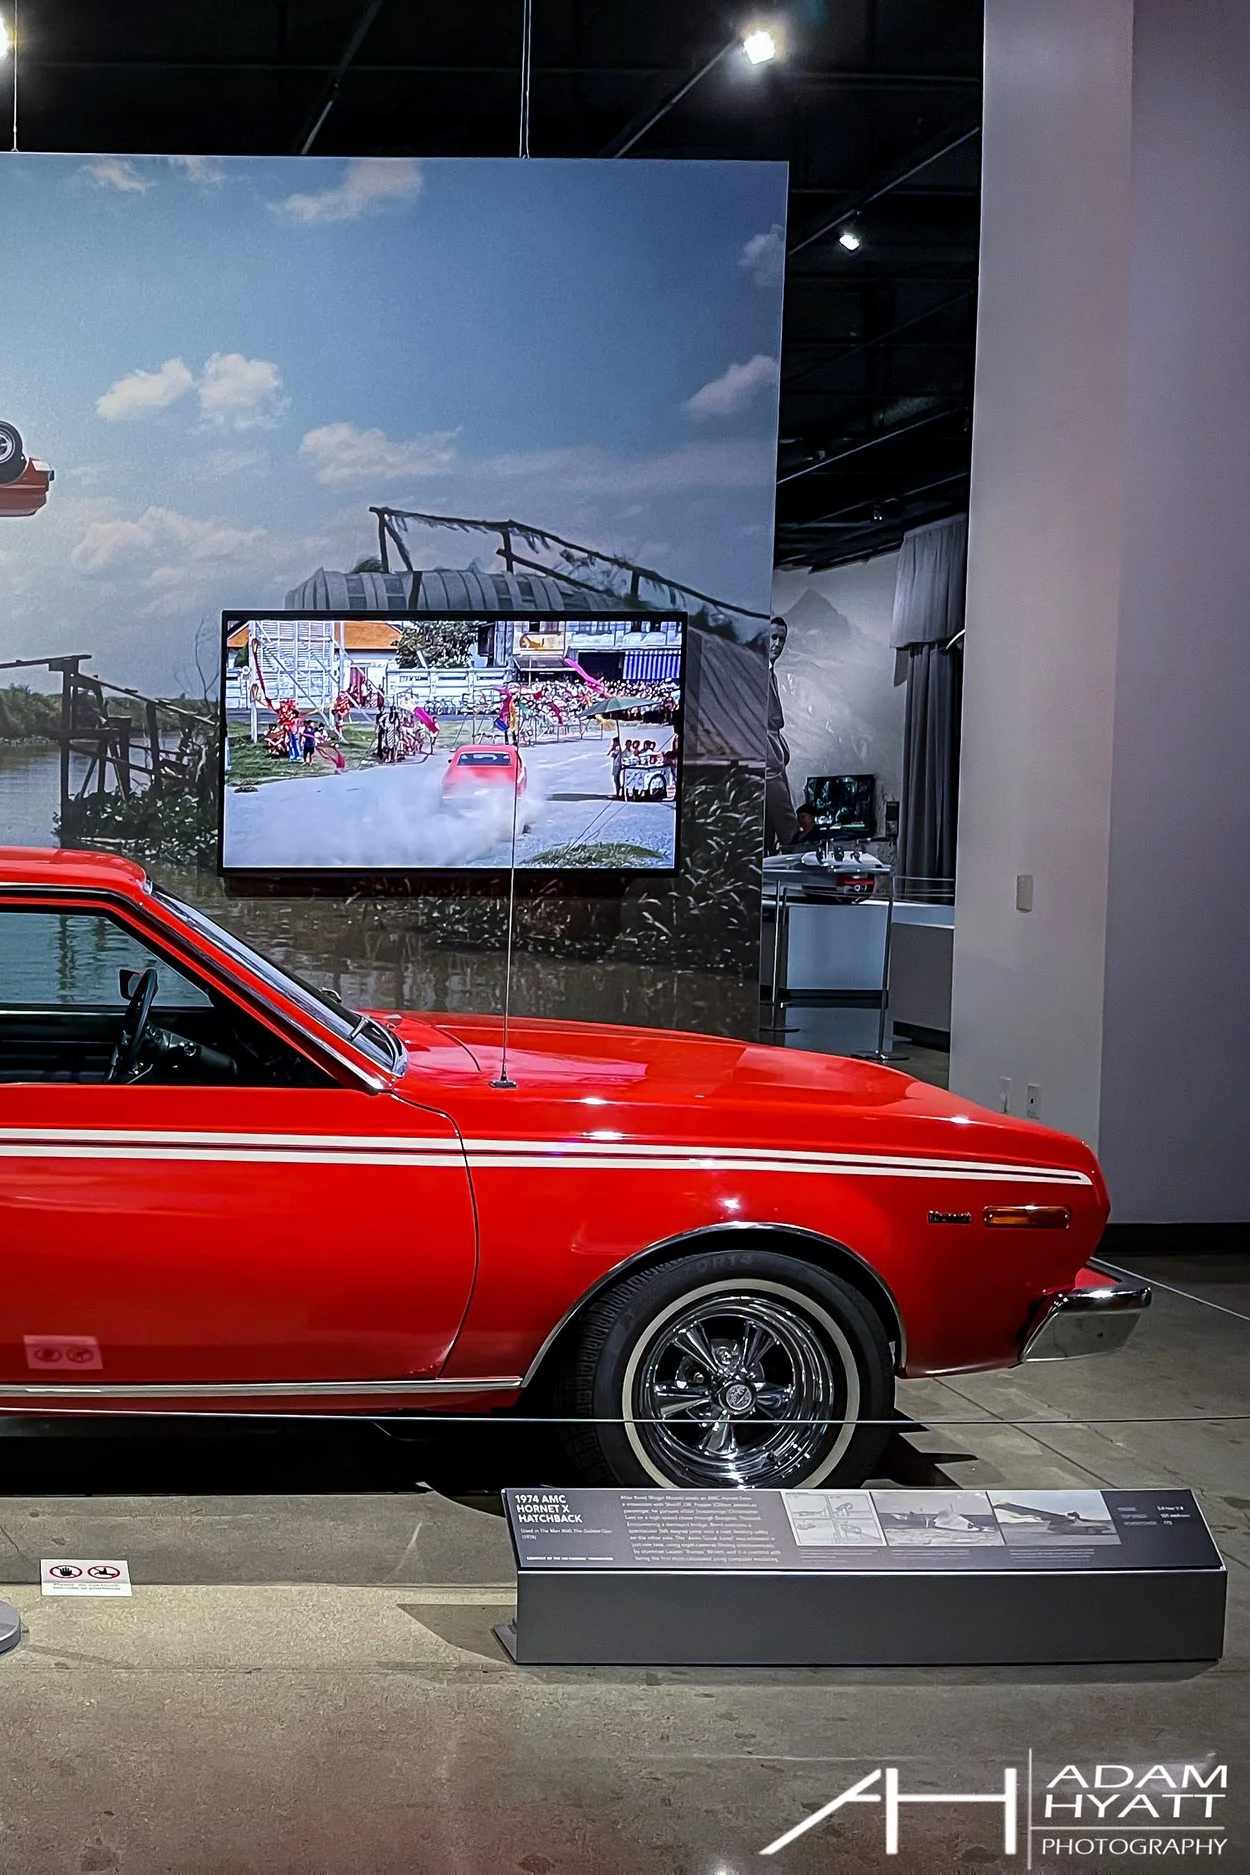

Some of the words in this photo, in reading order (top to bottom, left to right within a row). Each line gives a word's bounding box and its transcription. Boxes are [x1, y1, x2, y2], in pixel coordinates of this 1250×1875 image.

[515, 1495, 539, 1503] 1974
[541, 1495, 567, 1503] AMC
[516, 1504, 560, 1513] HORNET
[562, 1504, 570, 1513] X
[518, 1514, 583, 1523] HATCHBACK
